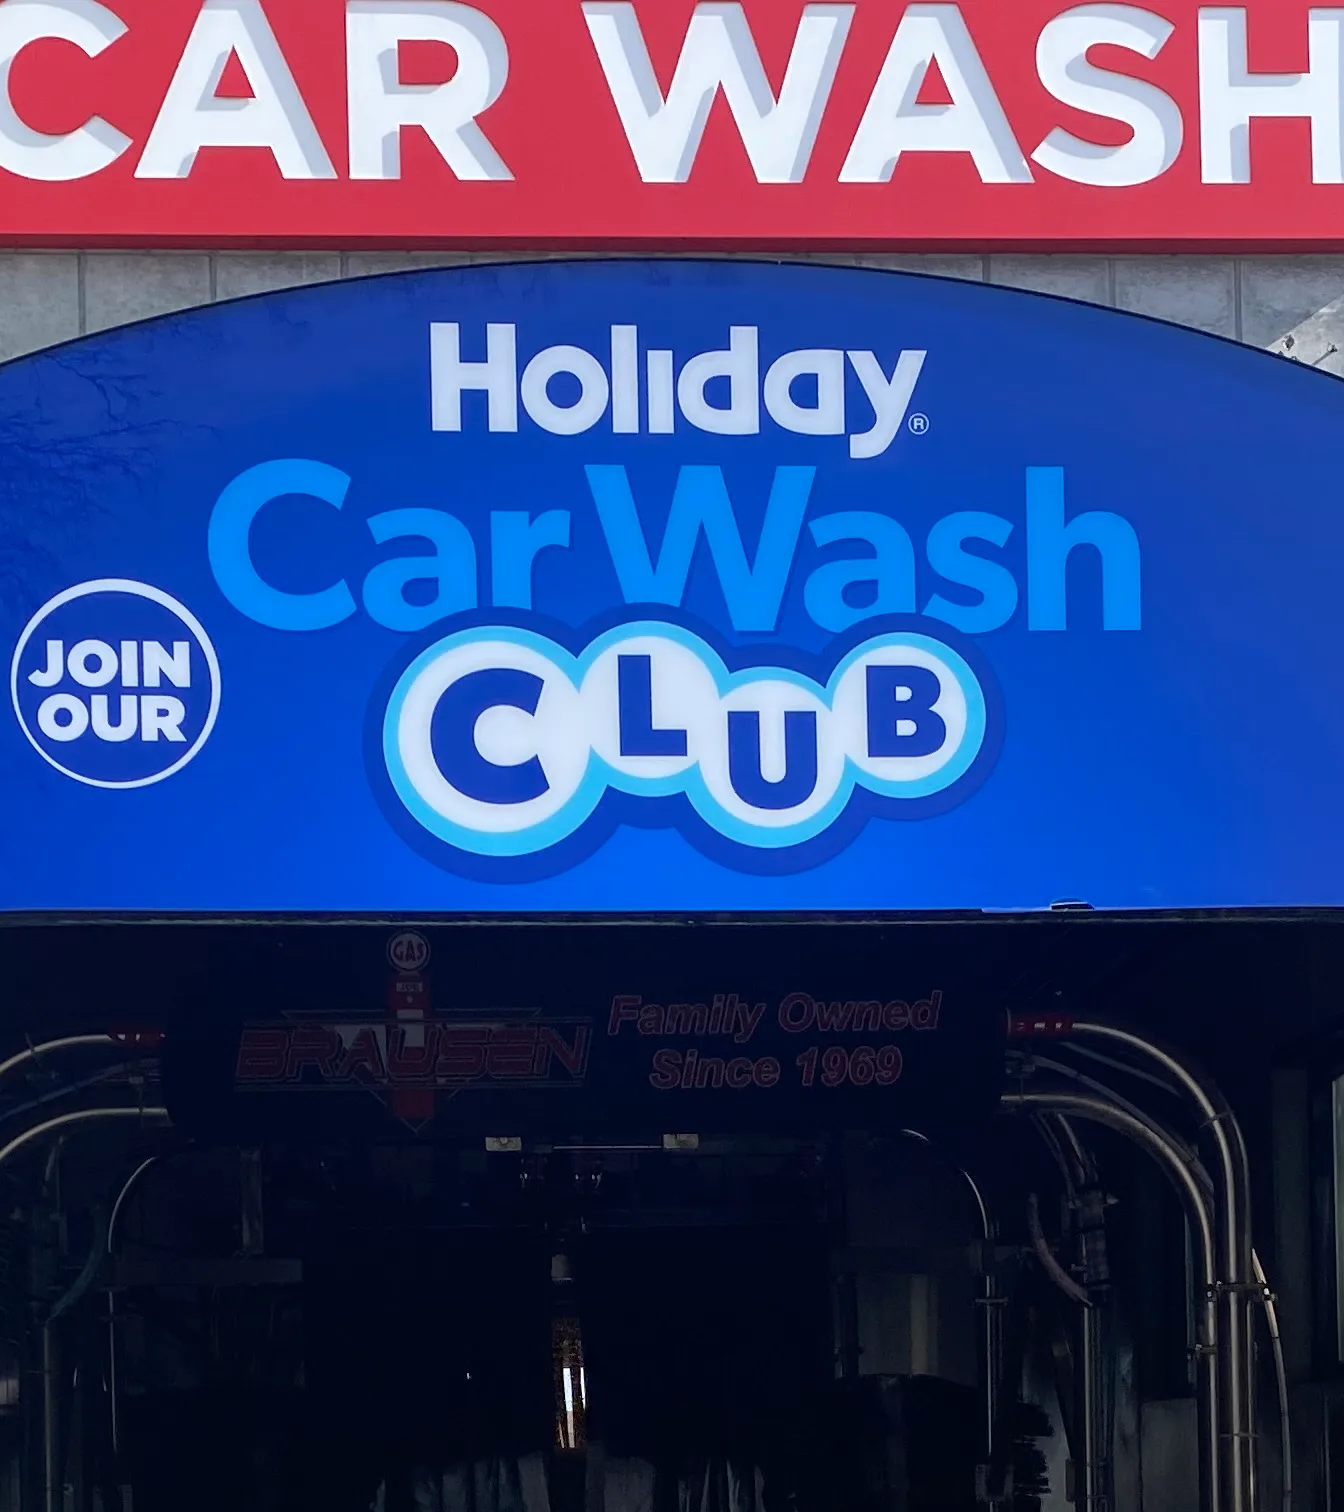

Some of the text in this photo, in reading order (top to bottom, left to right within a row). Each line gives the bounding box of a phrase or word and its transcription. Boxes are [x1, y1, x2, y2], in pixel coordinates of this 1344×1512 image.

[27, 639, 191, 688] JOIN
[37, 693, 186, 743] OUR
[429, 654, 947, 810] CLUB
[393, 941, 424, 962] GAS
[607, 990, 943, 1043] Family Owned
[235, 1024, 592, 1082] BRAUSEN
[649, 1044, 903, 1088] Since 1969
